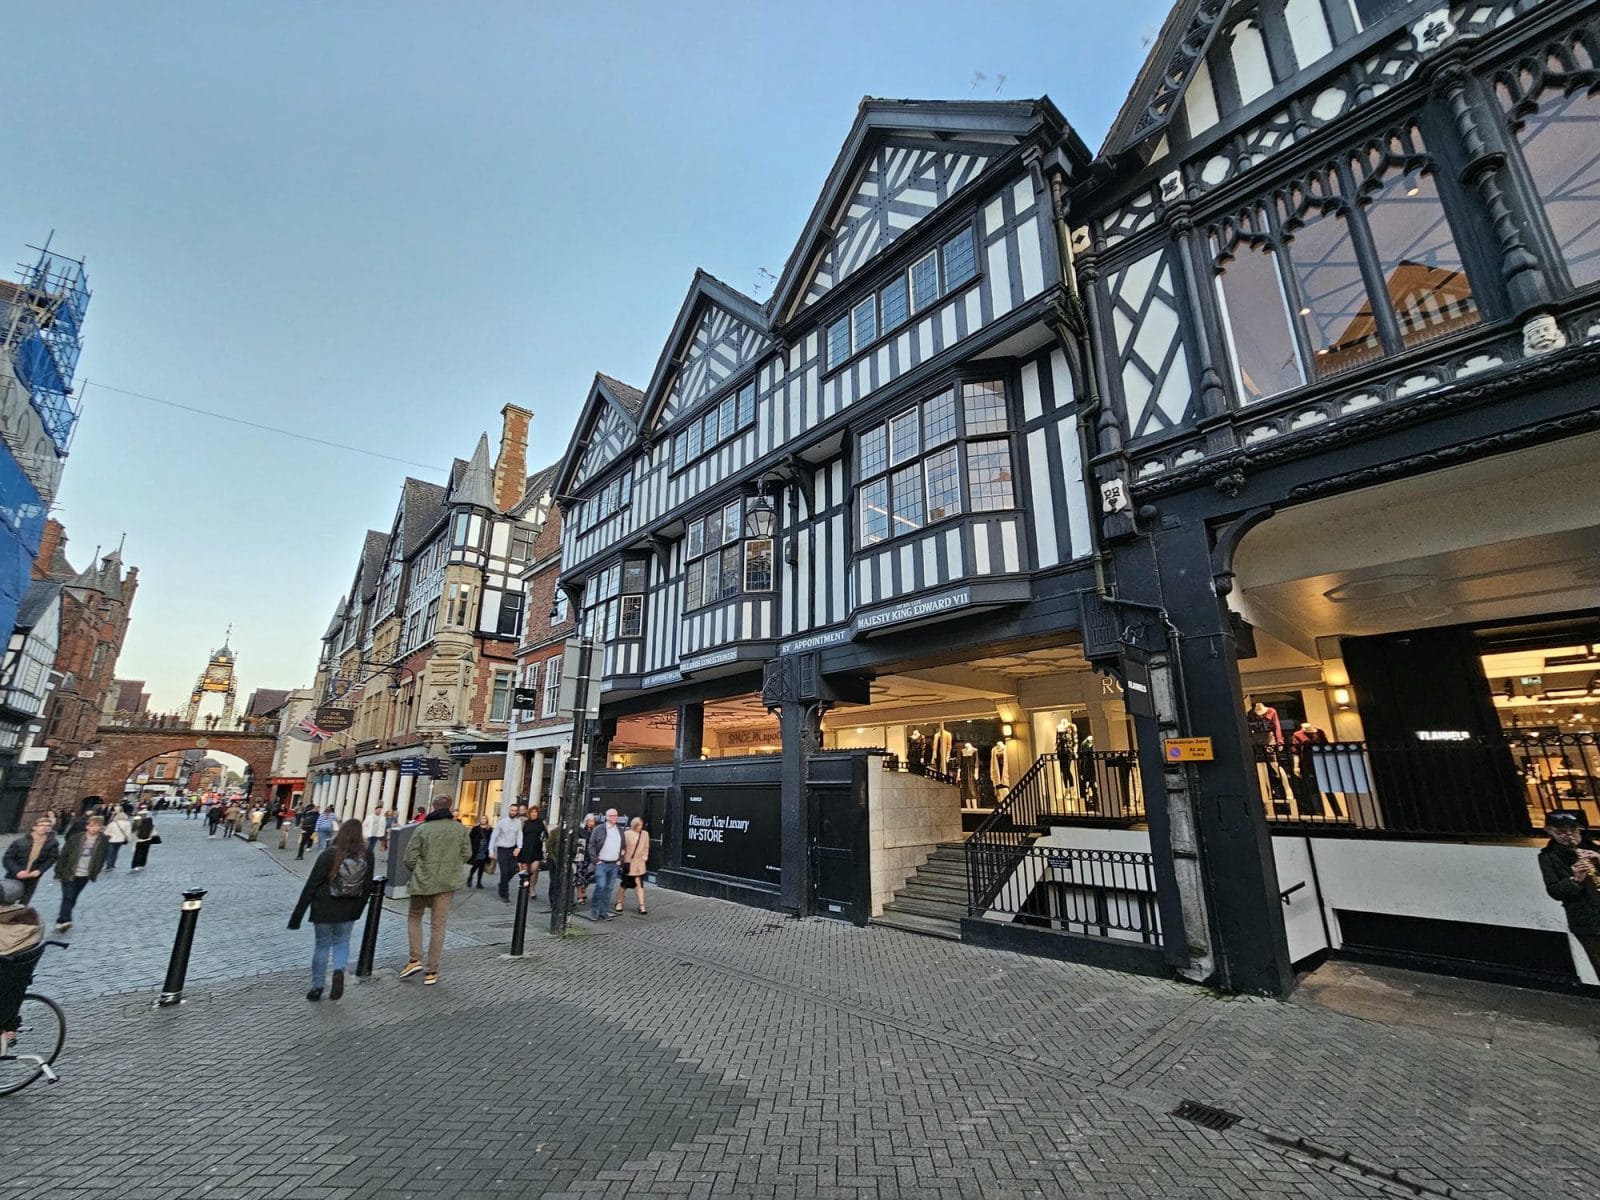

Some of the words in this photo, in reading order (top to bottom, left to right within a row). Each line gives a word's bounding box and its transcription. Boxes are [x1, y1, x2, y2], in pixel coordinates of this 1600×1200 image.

[857, 612, 891, 630] MAJESTY
[891, 606, 913, 621] KING
[913, 597, 951, 616] EDWARD
[952, 592, 968, 605] VII
[782, 644, 792, 653] BY
[794, 631, 846, 651] APPOINTMENT
[688, 814, 712, 827] Discover
[712, 815, 726, 828] New
[725, 815, 750, 833] Luxury
[688, 827, 724, 843] IN-STORE
